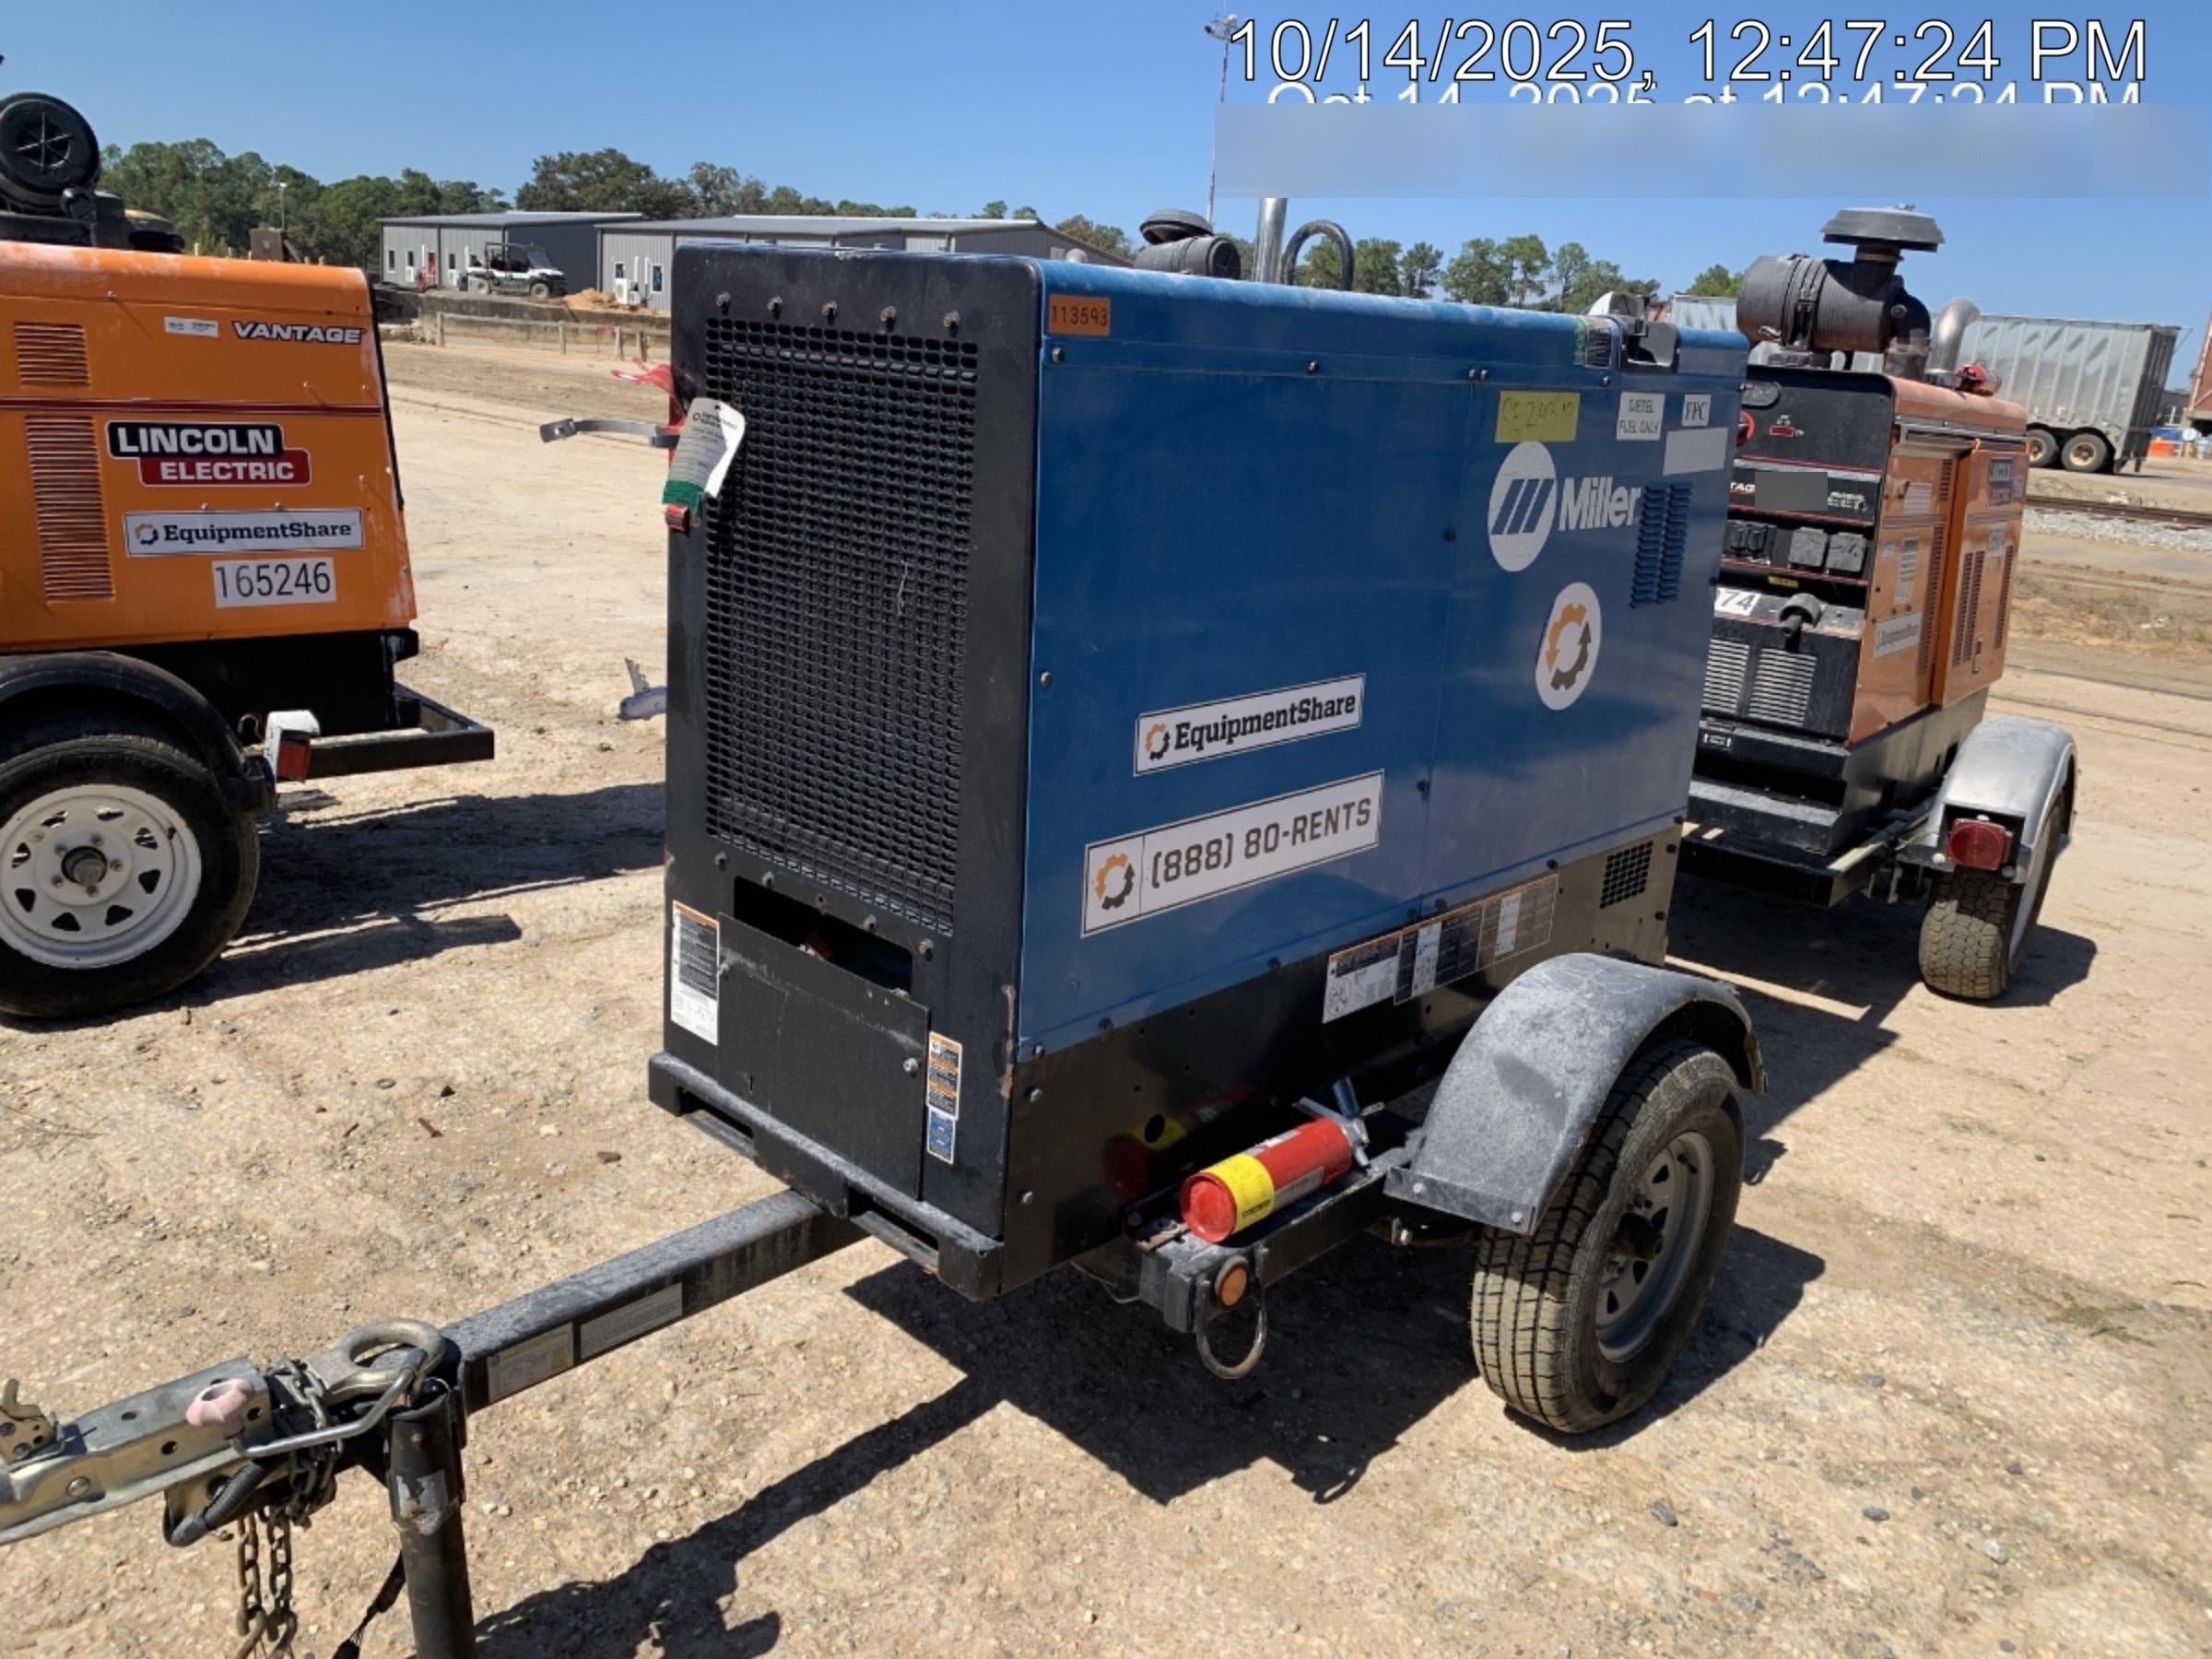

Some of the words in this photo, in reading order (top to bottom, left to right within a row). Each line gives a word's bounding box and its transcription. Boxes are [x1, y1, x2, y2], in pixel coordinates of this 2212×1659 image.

[1053, 305, 1108, 327] 113593
[232, 321, 361, 345] VANTAGE
[117, 427, 276, 454] LINCOLN
[159, 461, 295, 481] ELECTRIC
[1558, 476, 1641, 532] Miller
[163, 522, 352, 544] EquipmentShare
[215, 561, 332, 598] 165246
[1173, 693, 1356, 751] EquipmentShare
[1152, 832, 1233, 888] (888)
[1244, 798, 1371, 860] 80-RENTS
